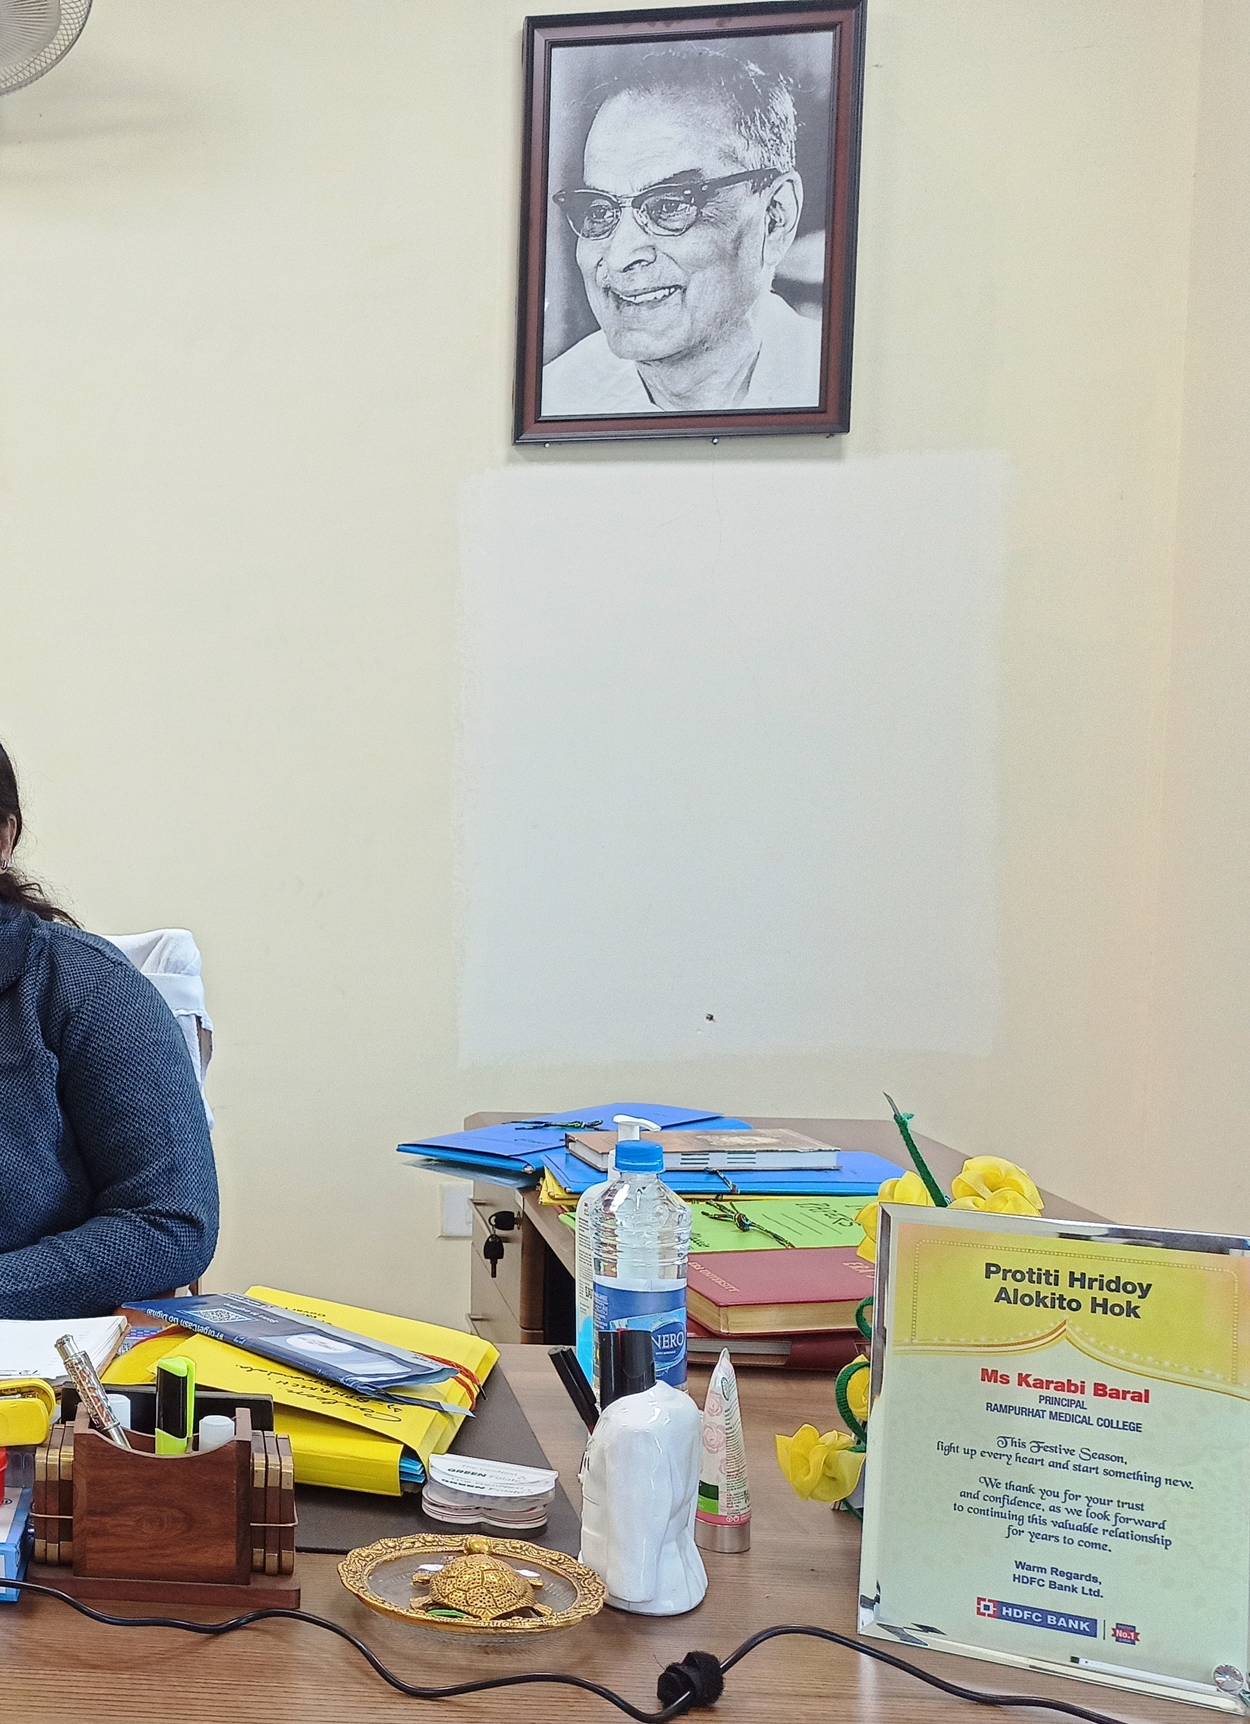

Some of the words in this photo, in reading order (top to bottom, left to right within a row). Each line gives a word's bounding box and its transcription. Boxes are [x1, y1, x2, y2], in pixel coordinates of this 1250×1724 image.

[985, 1262, 1059, 1287] Protiti
[1068, 1268, 1152, 1299] Hridoy
[994, 1287, 1082, 1312] Alokito
[1090, 1296, 1140, 1319] Hok
[981, 1368, 1010, 1386] Ms
[1017, 1372, 1085, 1395] Karabi
[1093, 1382, 1150, 1404] Baral
[986, 1402, 1047, 1419] RAMPURHAT
[1049, 1410, 1093, 1426] MEDICAL
[1096, 1417, 1142, 1433] COLLEGE
[1039, 1394, 1087, 1410] PRINCIPAL
[937, 1440, 959, 1455] light
[963, 1447, 977, 1458] up
[980, 1449, 1012, 1467] every
[1015, 1451, 1045, 1466] heart
[1048, 1457, 1069, 1471] and
[1072, 1462, 1100, 1475] start
[1103, 1464, 1162, 1488] something
[1164, 1477, 1194, 1490] new.
[996, 1435, 1026, 1450] This
[1029, 1440, 1076, 1457] Festive
[1079, 1447, 1128, 1465] Season,
[979, 1475, 1001, 1490] We
[1005, 1479, 1035, 1494] thank
[1039, 1487, 1060, 1500] you
[1063, 1488, 1082, 1503] for
[1084, 1494, 1113, 1507] your
[1116, 1498, 1144, 1511] trust
[959, 1488, 980, 1499] and
[983, 1490, 1045, 1513] confidence,
[1049, 1503, 1061, 1513] as
[1065, 1505, 1083, 1517] we
[1085, 1506, 1111, 1522] look
[1113, 1511, 1166, 1531] forward
[953, 1503, 964, 1512] to
[967, 1504, 1024, 1524] continuing
[1027, 1513, 1047, 1526] this
[1050, 1517, 1098, 1535] valuable
[1102, 1524, 1172, 1549] relationship
[1006, 1524, 1025, 1539] for
[1028, 1530, 1059, 1543] years
[1063, 1534, 1074, 1545] to
[1077, 1539, 1112, 1553] come.
[1012, 1574, 1045, 1588] HDFC
[1049, 1580, 1079, 1594] Bank
[1081, 1585, 1104, 1598] Ltd.
[1015, 1560, 1047, 1575] Warm
[1050, 1566, 1102, 1585] Regards,
[1002, 1606, 1042, 1622] HDFC
[1047, 1615, 1090, 1632] BANK
[1116, 1629, 1135, 1640] No.1
